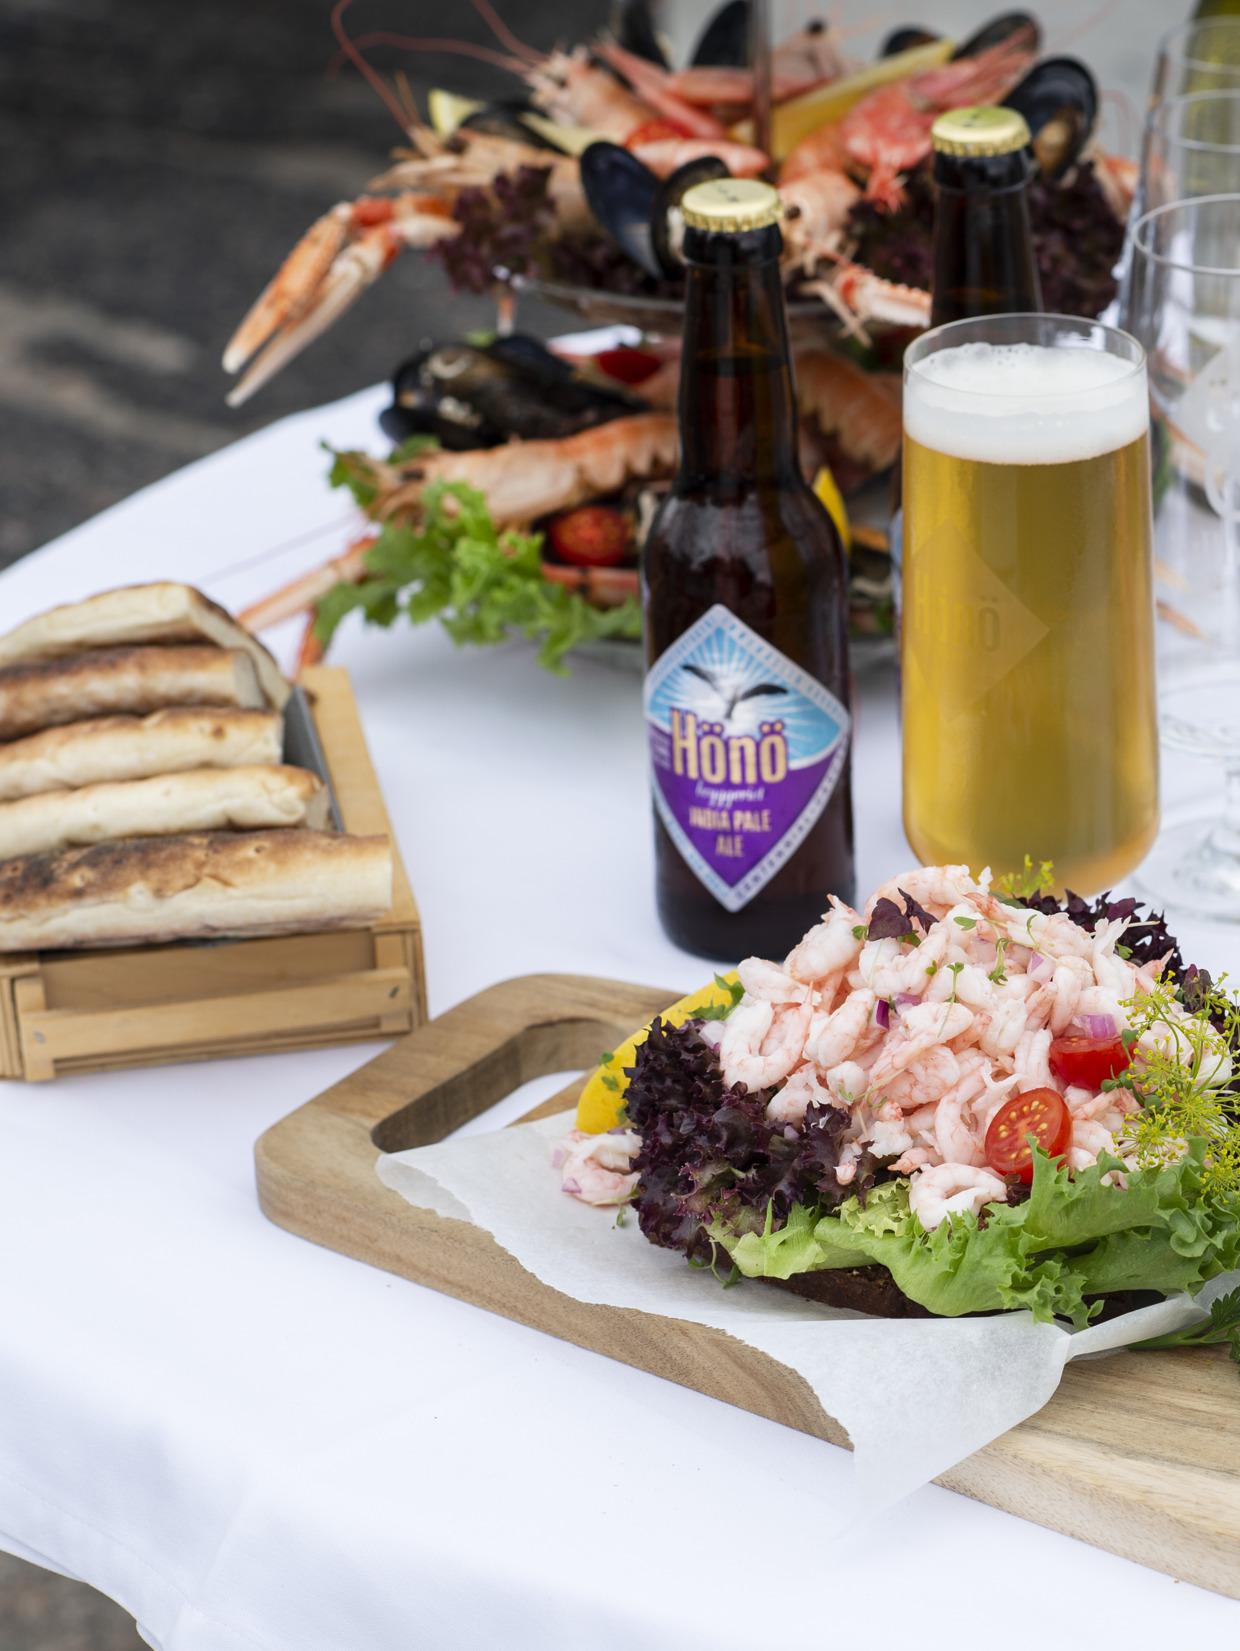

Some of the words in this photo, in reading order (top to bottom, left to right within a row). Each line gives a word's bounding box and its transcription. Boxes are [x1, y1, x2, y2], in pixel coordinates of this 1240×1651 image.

[671, 707, 788, 784] Hönö
[688, 806, 731, 832] INDIA
[733, 809, 772, 833] PALE
[715, 833, 744, 857] ALE
